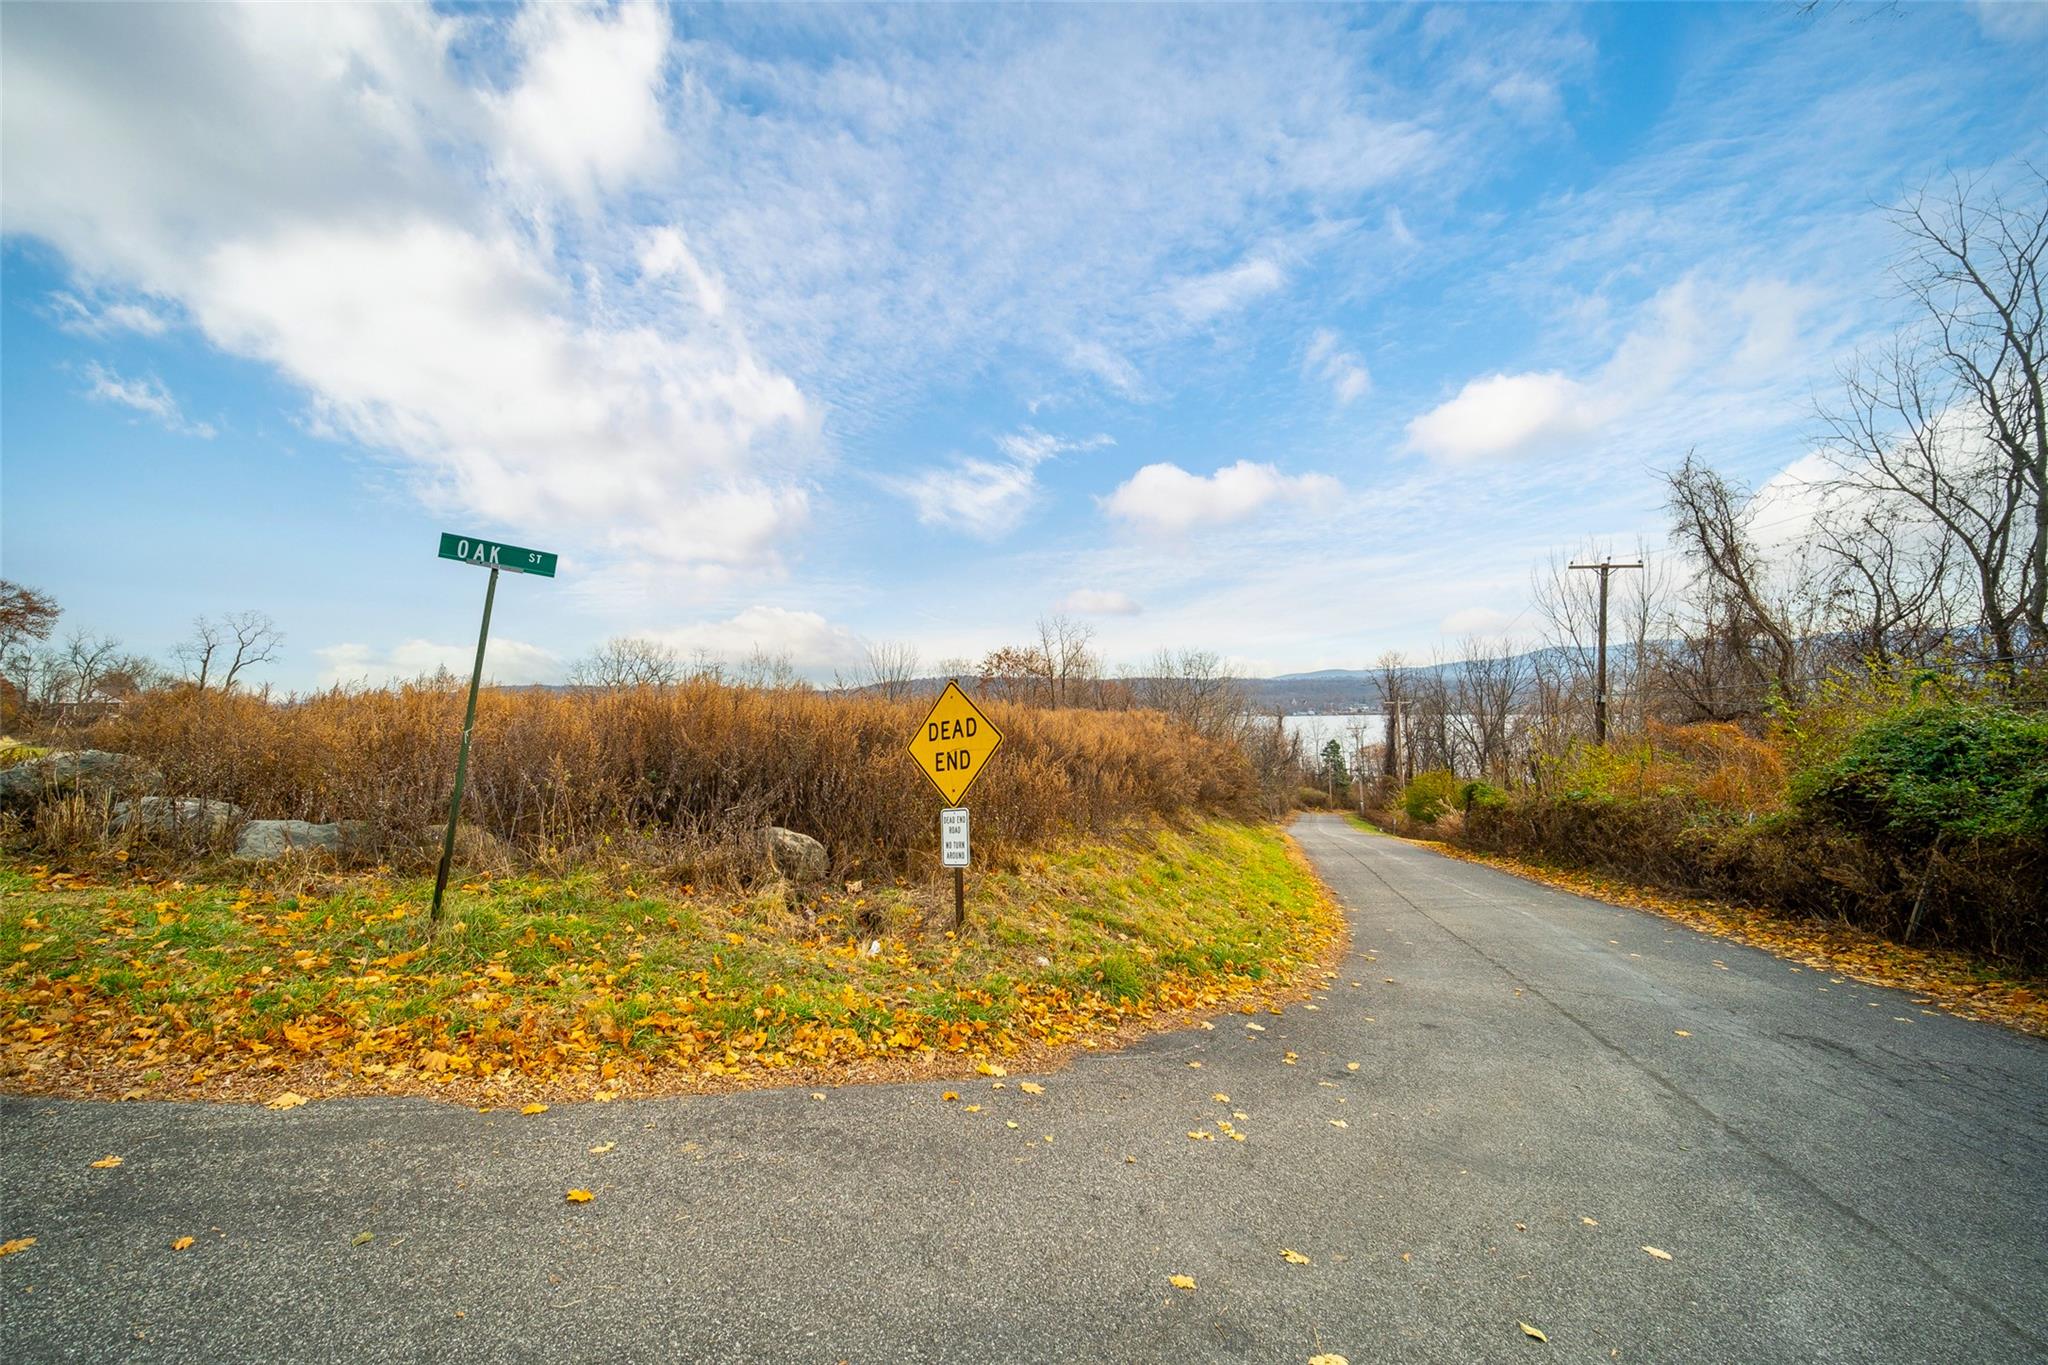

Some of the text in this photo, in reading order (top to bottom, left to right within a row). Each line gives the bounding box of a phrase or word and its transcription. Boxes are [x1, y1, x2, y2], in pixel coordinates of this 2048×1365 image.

[457, 540, 542, 564] OAK ST
[929, 717, 977, 741] DEAD
[935, 750, 970, 772] END
[944, 816, 955, 824] DEAD
